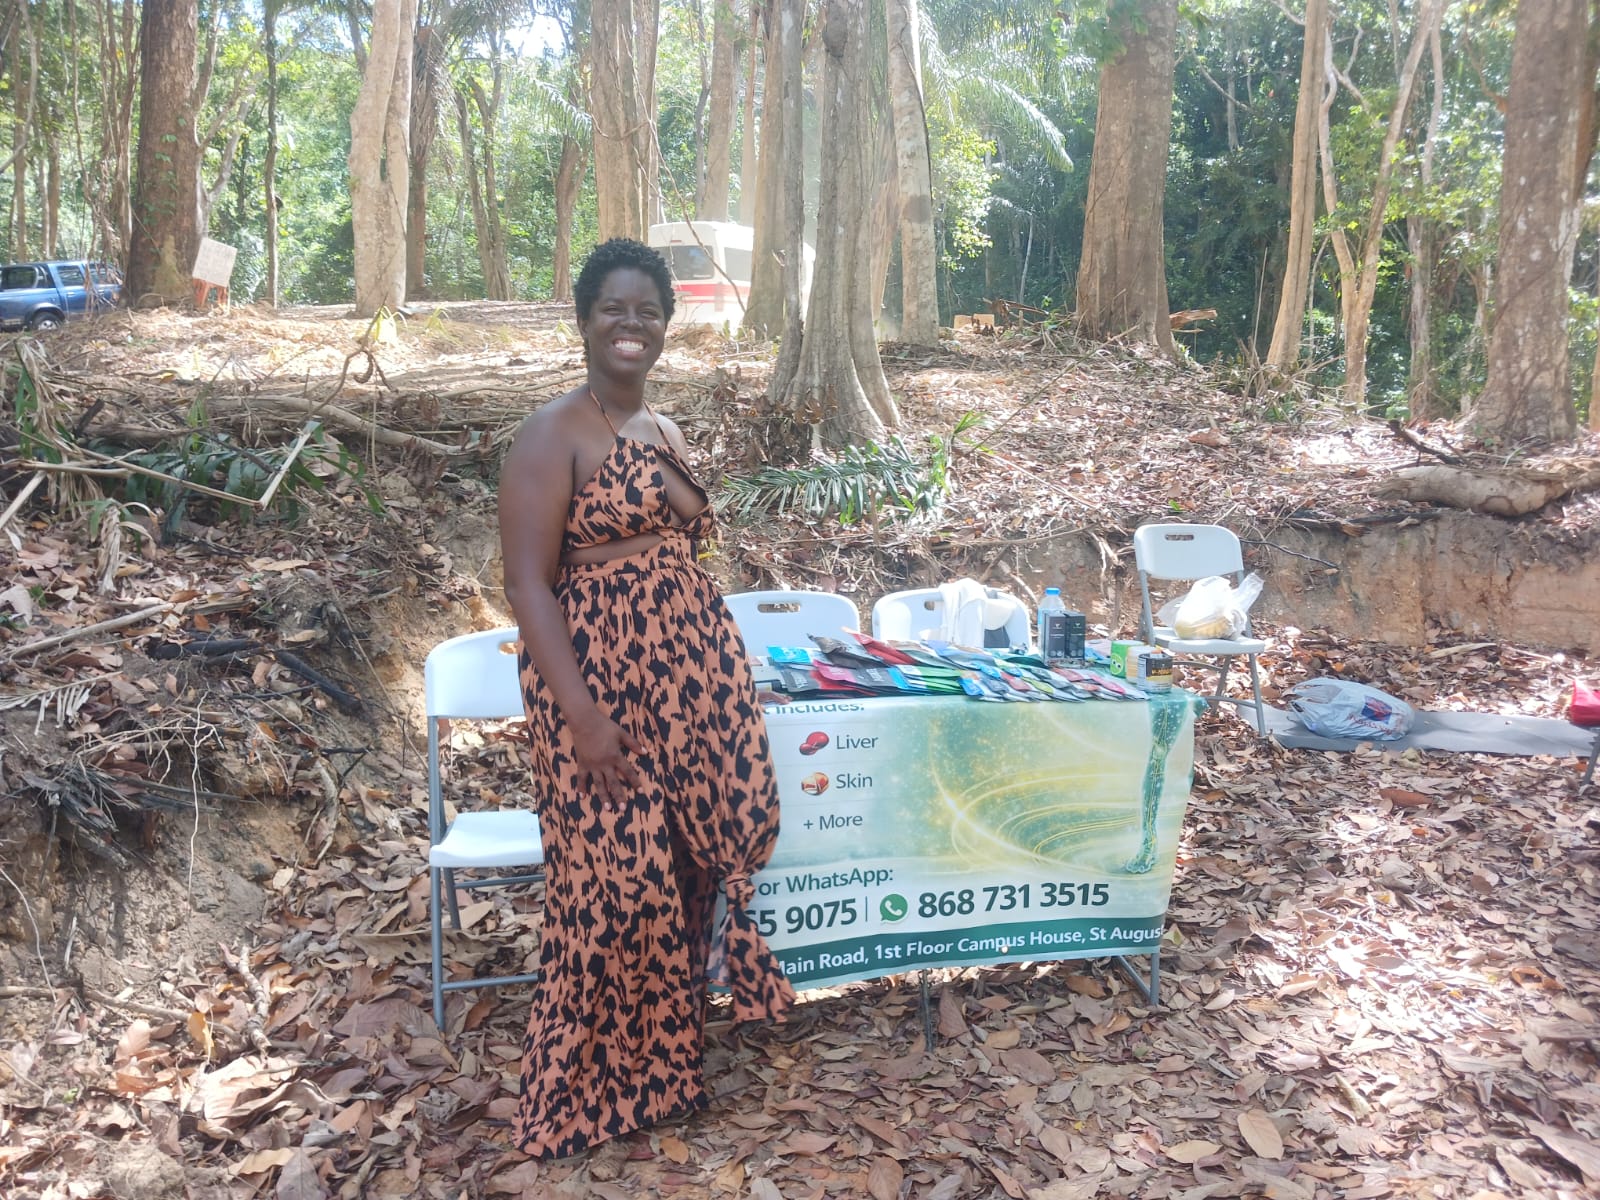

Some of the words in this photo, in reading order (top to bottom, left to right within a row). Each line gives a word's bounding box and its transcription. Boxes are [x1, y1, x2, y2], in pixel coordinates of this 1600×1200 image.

[836, 734, 879, 750] Liver
[836, 773, 873, 789] Skin
[819, 814, 863, 831] More
[758, 882, 780, 896] or
[785, 867, 893, 893] WhatsApp:
[785, 898, 858, 934] 9075
[918, 889, 975, 918] 868
[982, 883, 1030, 912] 731
[1040, 883, 1109, 908] 3515
[819, 947, 869, 970] Road,
[875, 944, 901, 960] 1st
[906, 940, 953, 957] Floor
[957, 934, 1025, 953] Campus
[1030, 929, 1086, 945] House,
[1089, 926, 1107, 941] St
